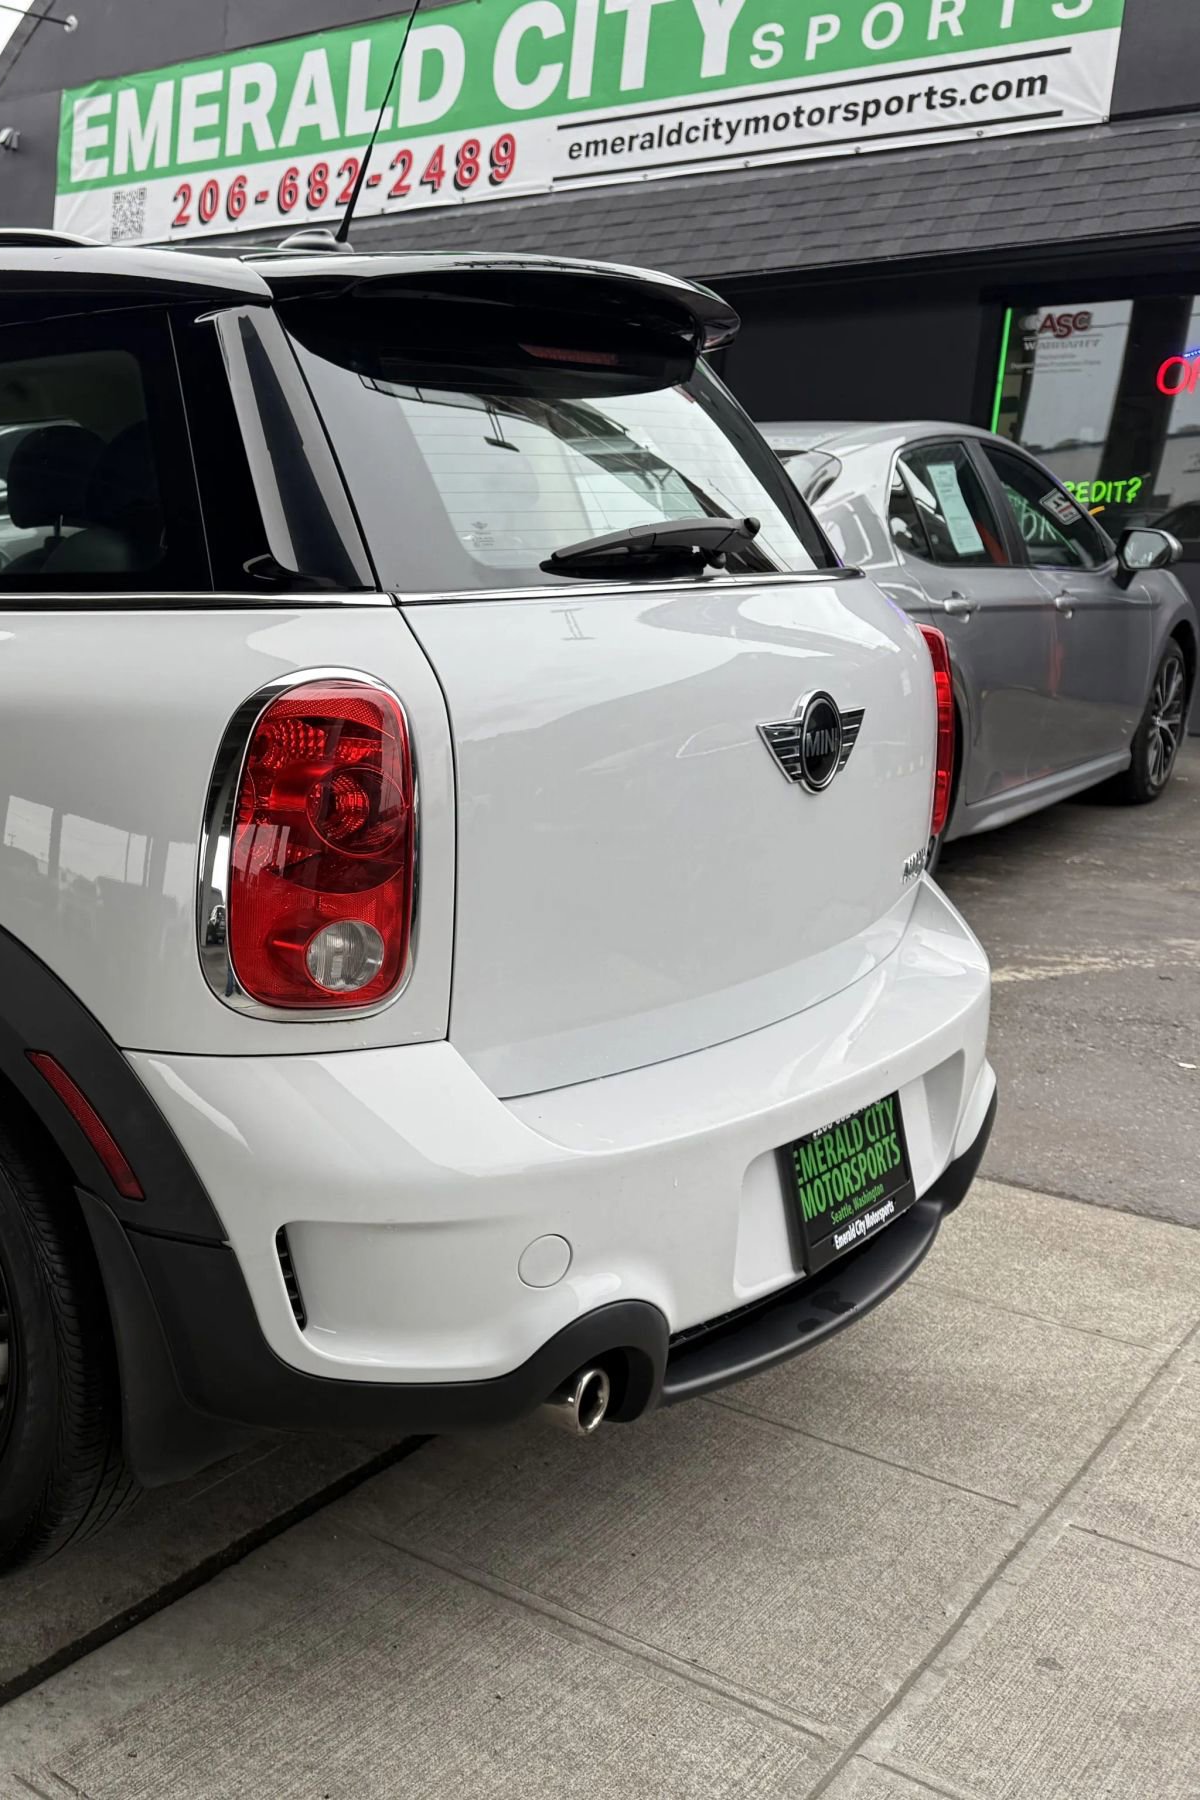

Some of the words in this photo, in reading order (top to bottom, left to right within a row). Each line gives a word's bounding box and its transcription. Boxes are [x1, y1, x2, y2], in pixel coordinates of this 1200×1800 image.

[70, 24, 466, 184] EMERALD
[493, 0, 746, 110] CITY
[567, 73, 1049, 161] emeraldcitymotorsports.com
[171, 133, 517, 228] 206-682-2489
[1038, 311, 1092, 338] ASC
[806, 728, 838, 757] MINI
[864, 1097, 894, 1143] CITY
[799, 1131, 901, 1222] MOTORSPORTS
[853, 1184, 885, 1210] Washington
[834, 1222, 857, 1250] Emerald
[855, 1219, 867, 1236] City
[864, 1200, 895, 1230] Motorsports
